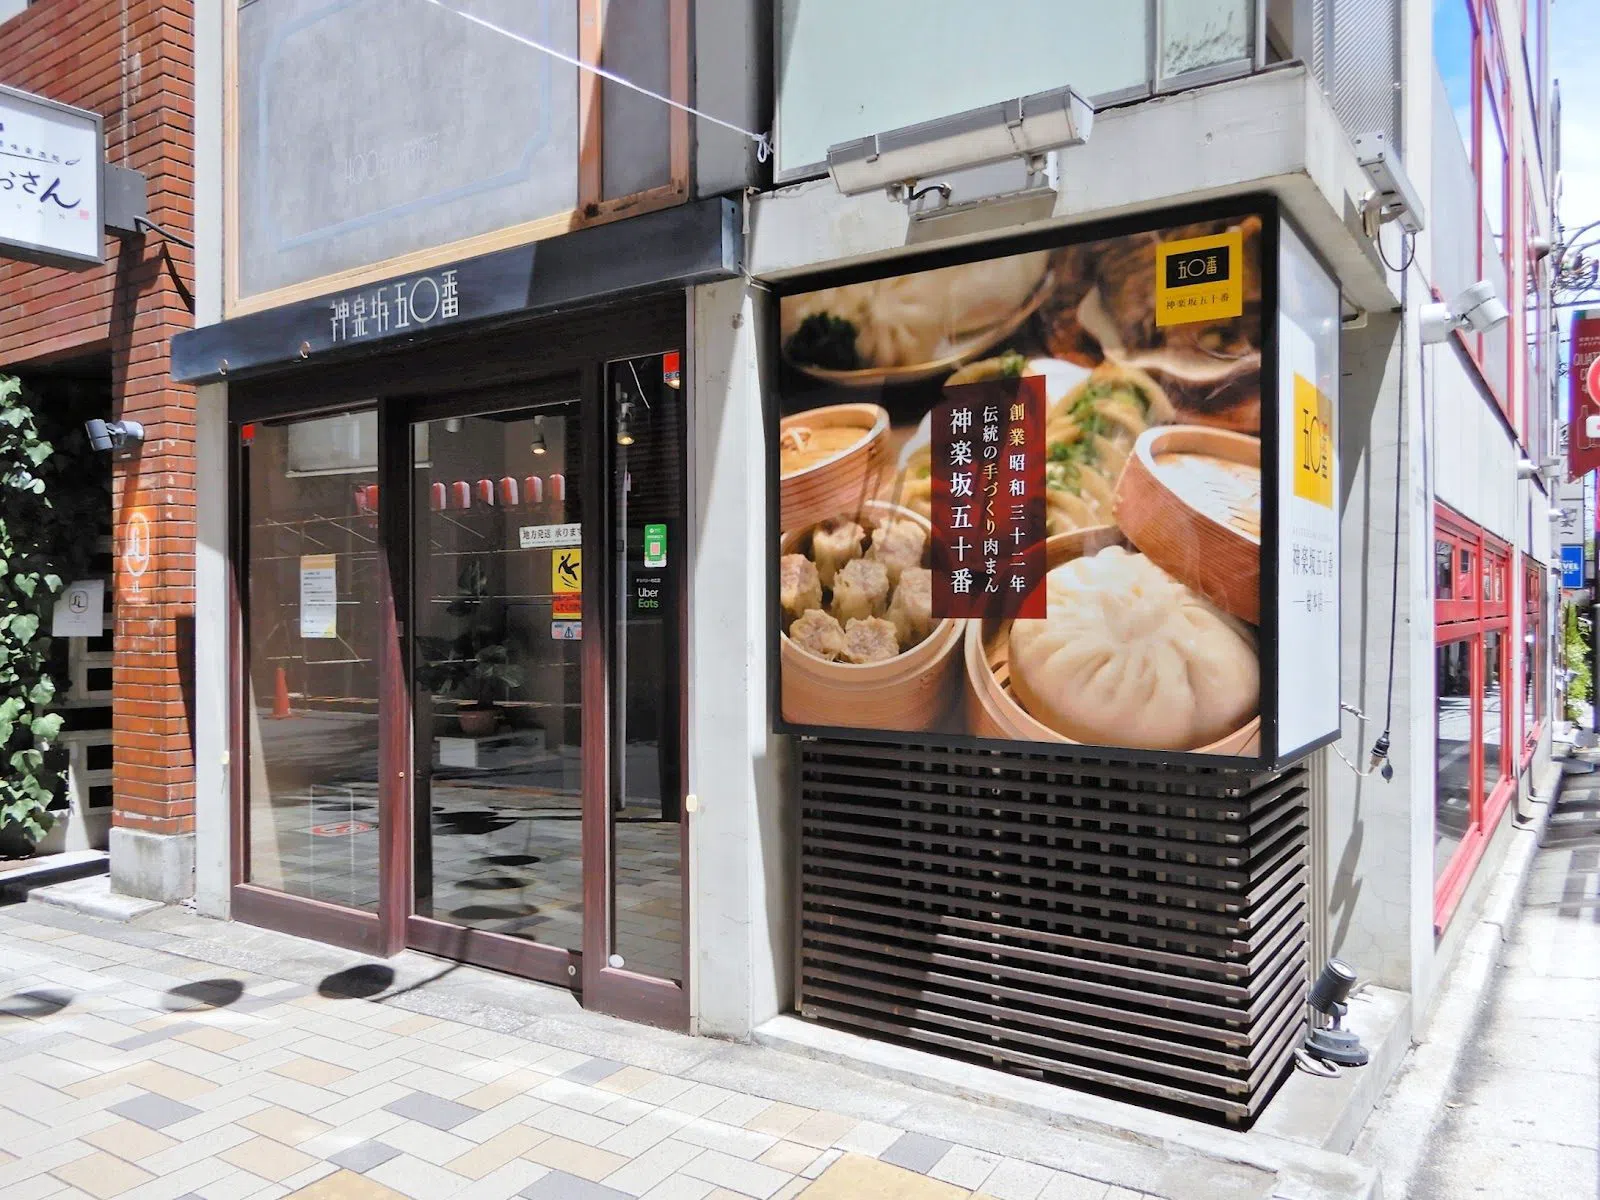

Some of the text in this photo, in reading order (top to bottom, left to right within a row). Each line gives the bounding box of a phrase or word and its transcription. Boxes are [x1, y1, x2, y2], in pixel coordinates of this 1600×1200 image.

[1177, 255, 1218, 280] 五〇番
[1166, 292, 1229, 310] 神楽坂五十番
[949, 408, 974, 595] 神楽坂五十番
[982, 405, 999, 594] 伝統の手づくり肉まん
[1009, 403, 1026, 593] 創業昭和三十二年
[522, 528, 552, 541] 地方発送
[637, 587, 659, 598] Uber
[637, 598, 659, 608] Eats
